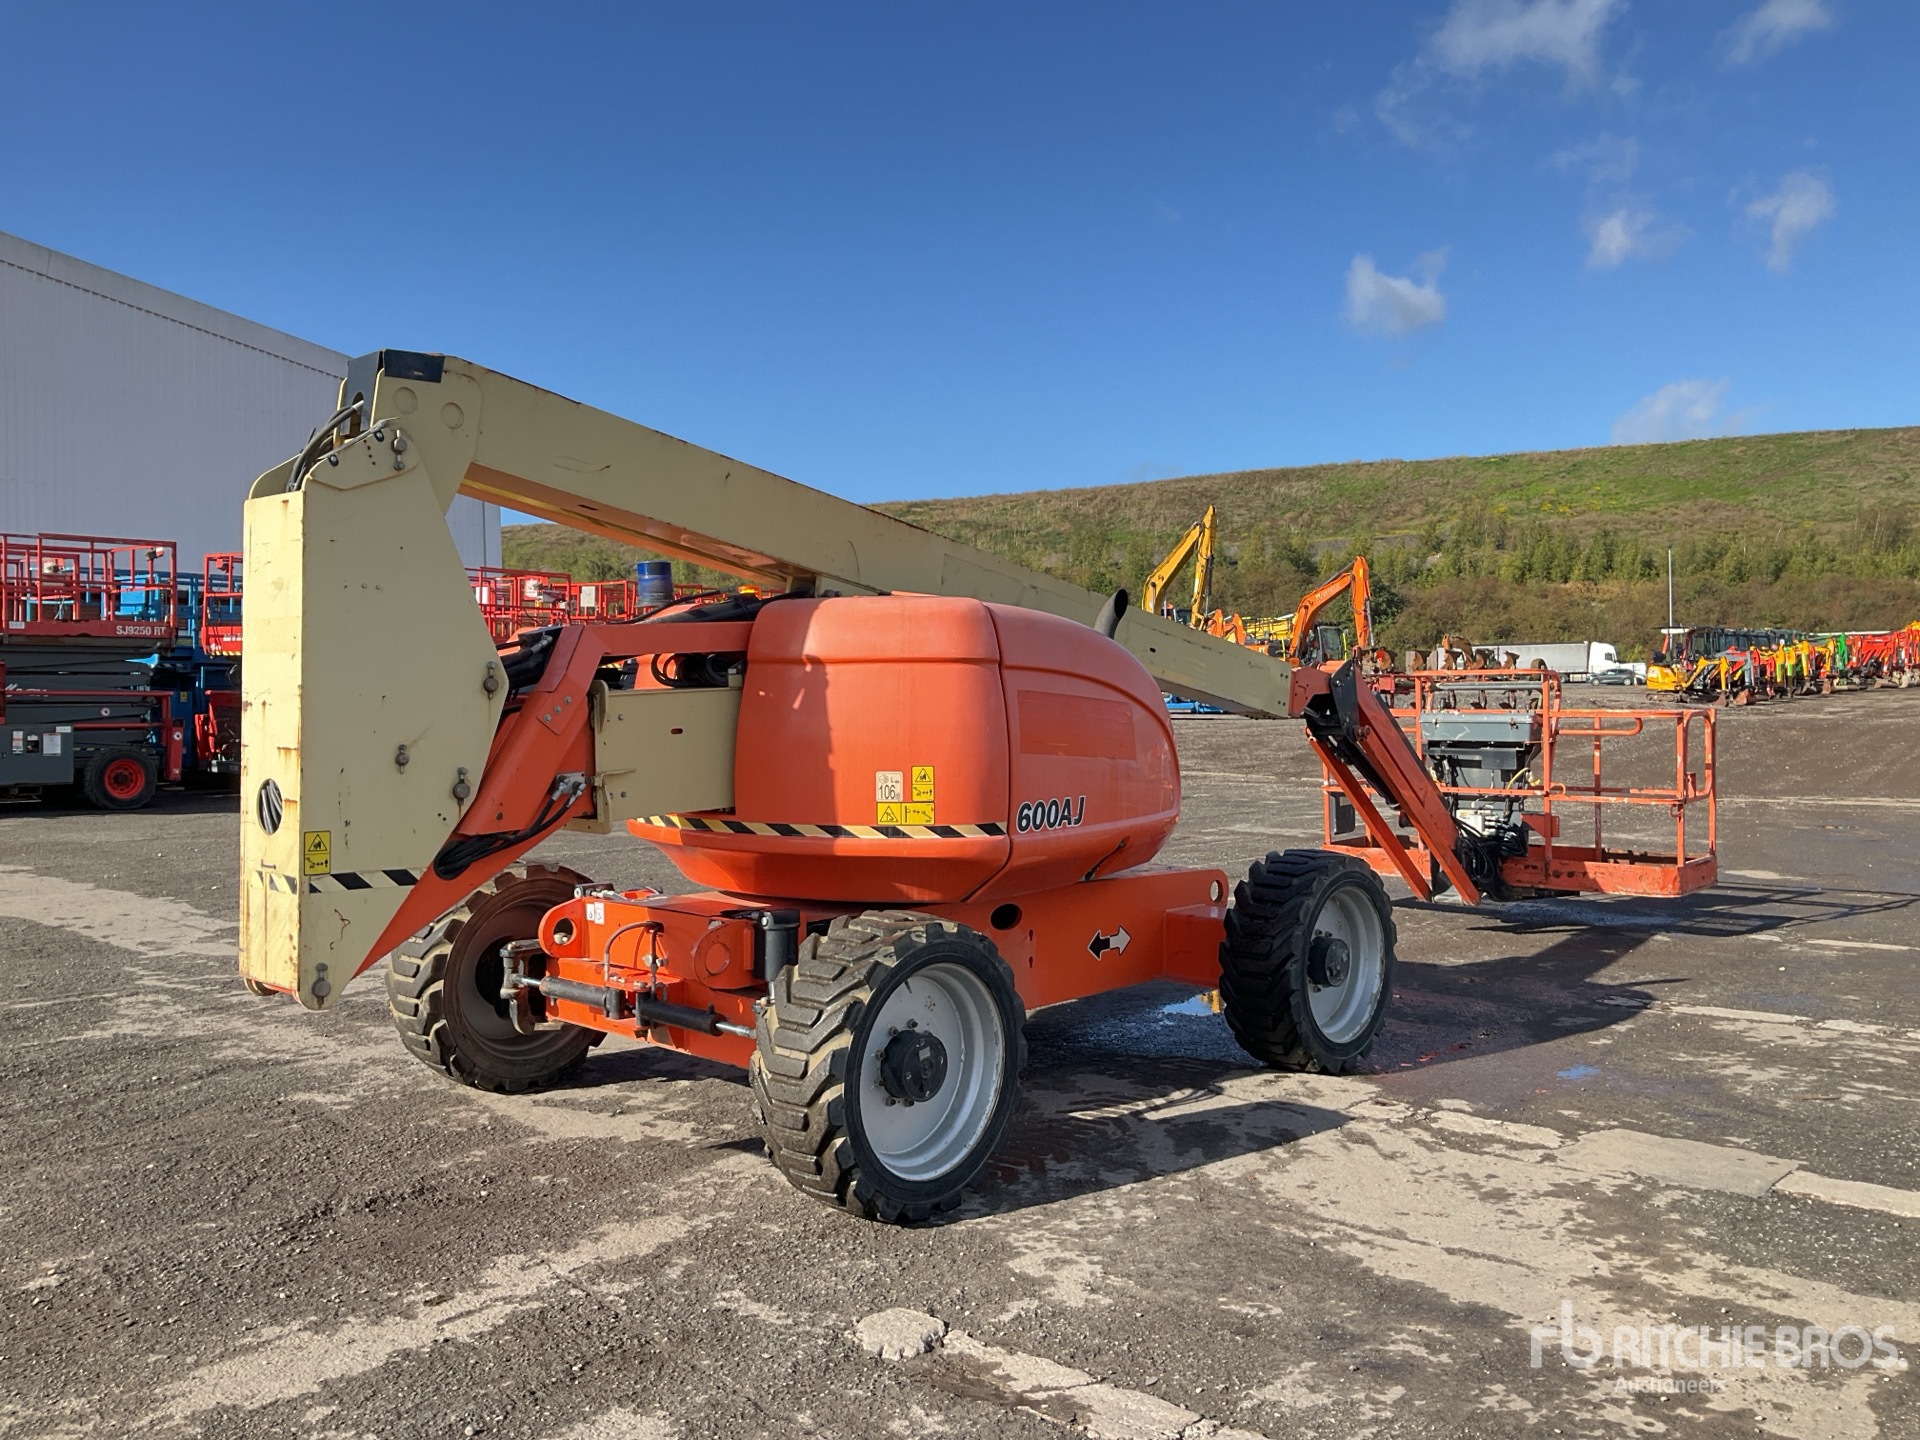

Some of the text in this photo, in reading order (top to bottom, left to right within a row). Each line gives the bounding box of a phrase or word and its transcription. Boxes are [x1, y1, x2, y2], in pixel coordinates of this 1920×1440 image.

[116, 625, 167, 636] SJ9250 RT
[879, 784, 896, 800] 106
[1016, 795, 1086, 834] 600AJ
